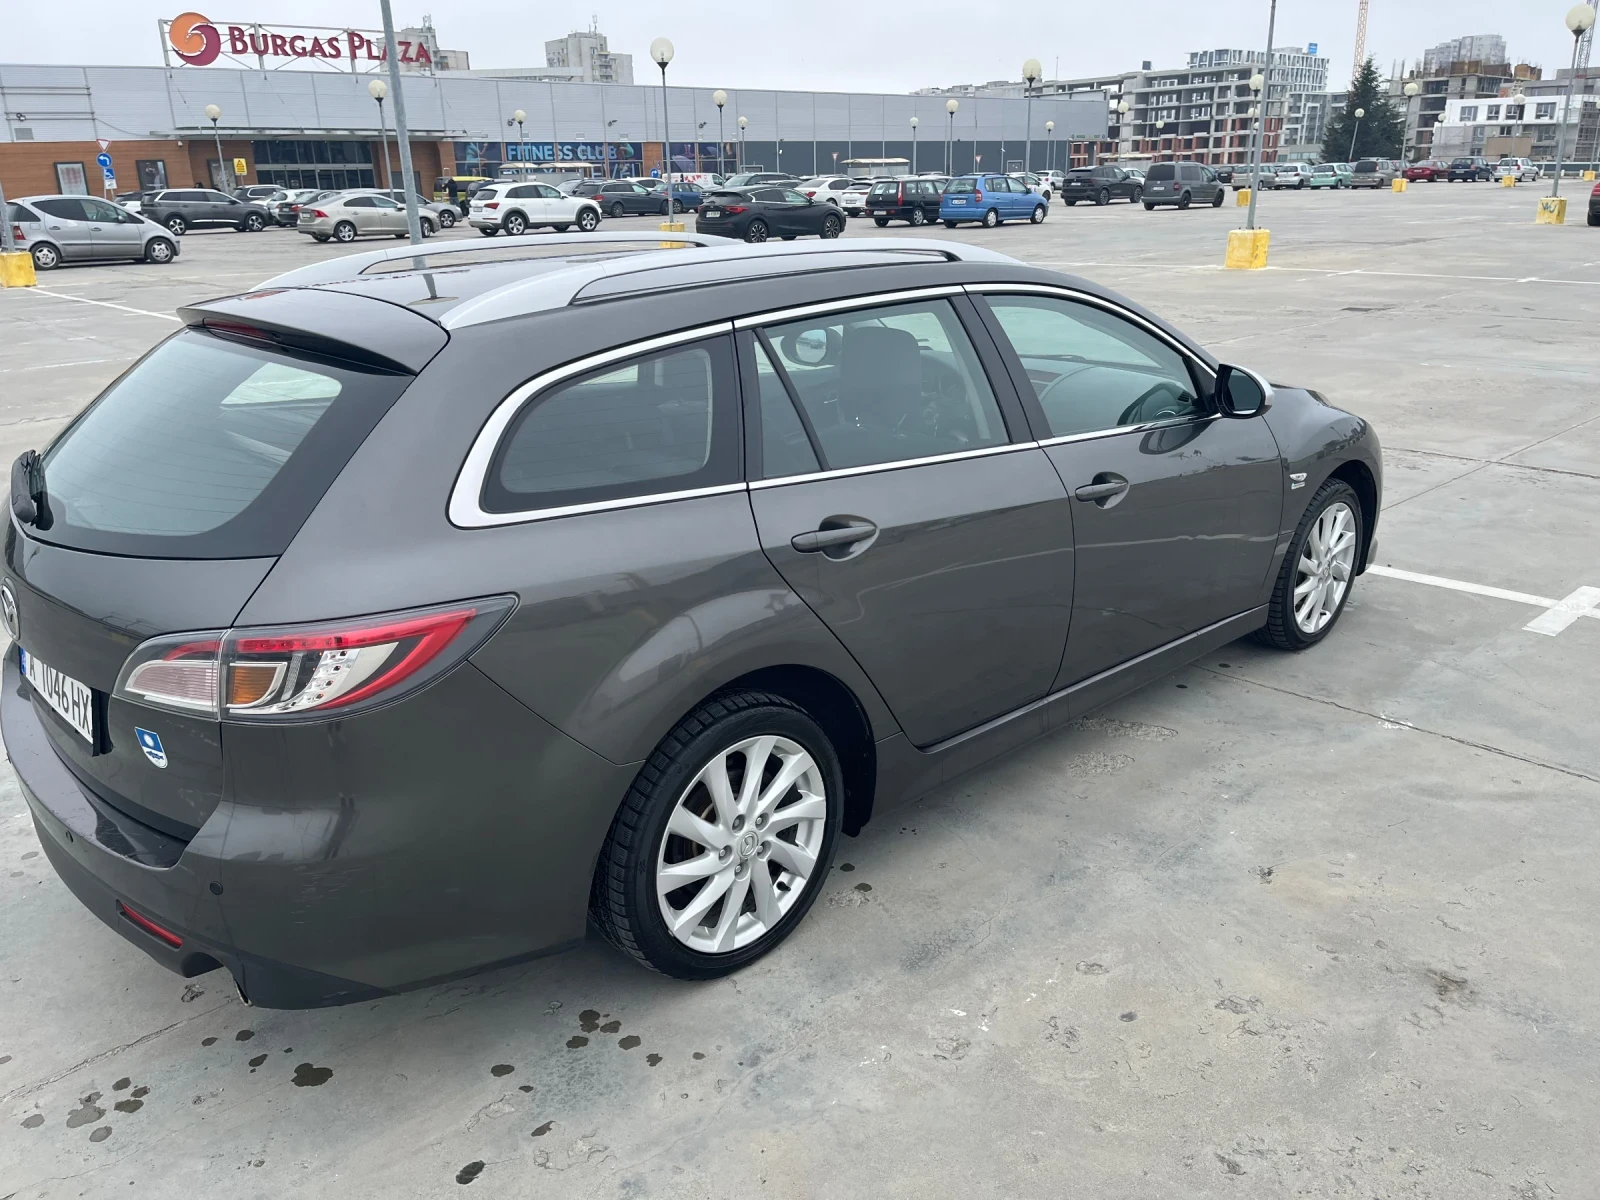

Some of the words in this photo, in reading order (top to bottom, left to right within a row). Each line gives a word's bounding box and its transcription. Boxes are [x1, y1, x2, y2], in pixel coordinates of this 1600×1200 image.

[228, 26, 342, 59] BURGAS
[507, 144, 573, 161] FITNESS
[577, 145, 618, 160] CLUB
[42, 663, 69, 714] 1046
[71, 681, 90, 735] HX
